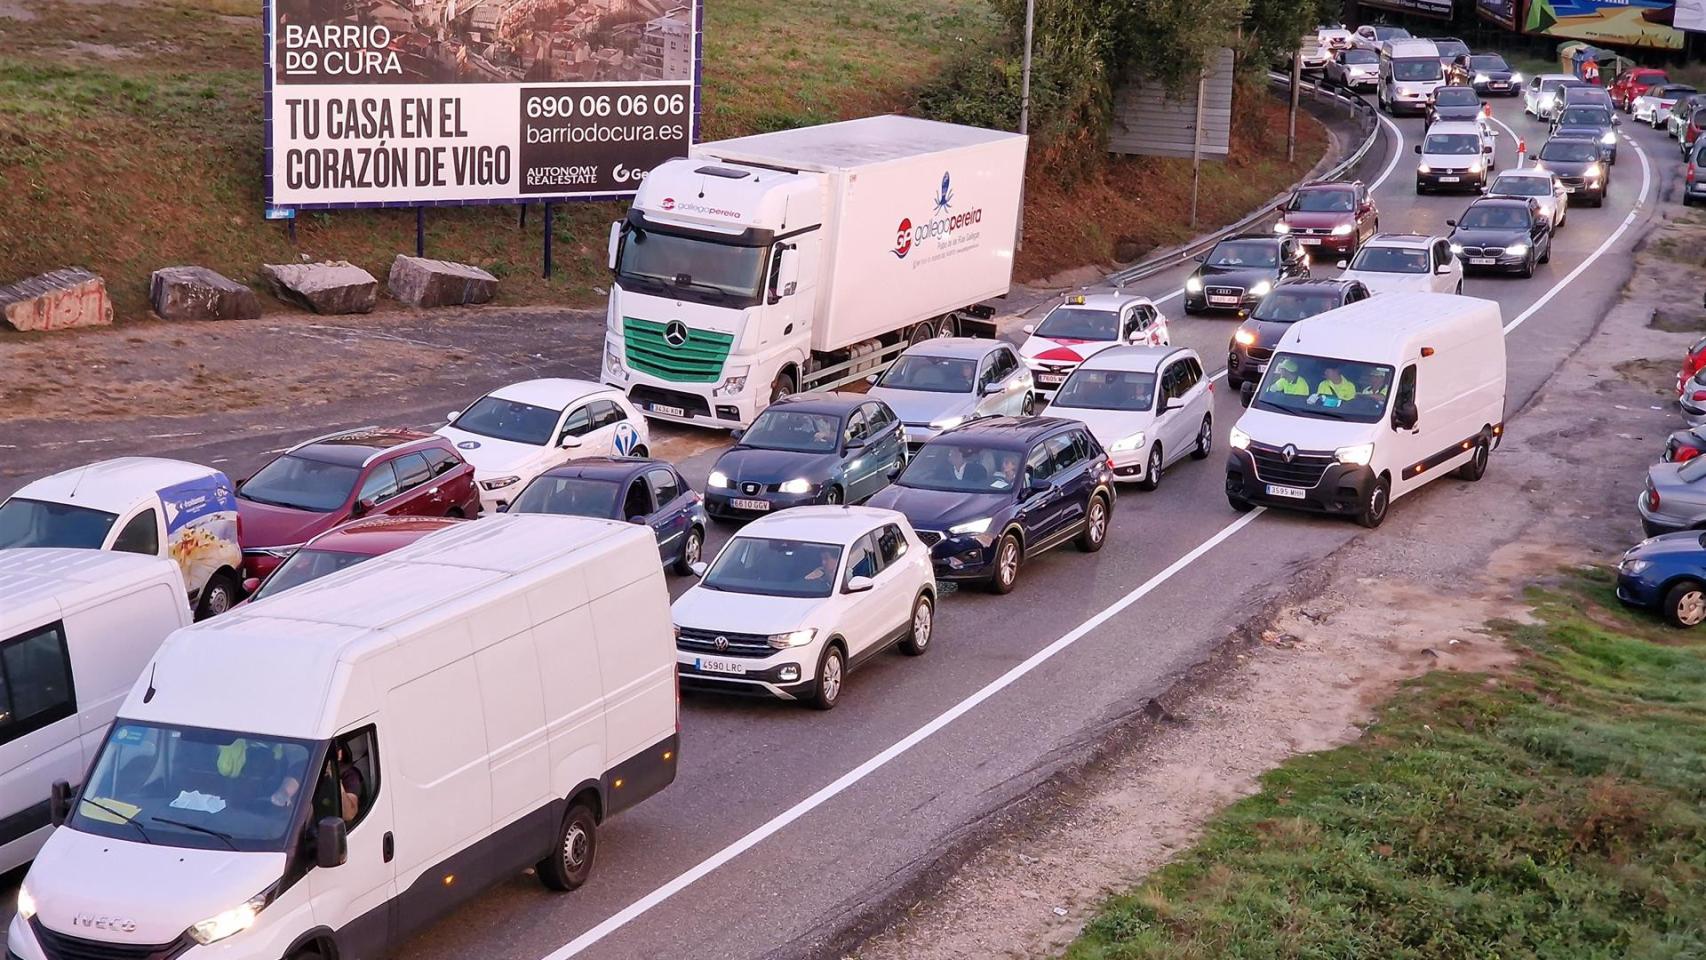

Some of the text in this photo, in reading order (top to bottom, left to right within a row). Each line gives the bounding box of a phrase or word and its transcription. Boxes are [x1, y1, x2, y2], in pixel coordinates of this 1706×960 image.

[286, 25, 391, 49] BARRIO
[286, 51, 403, 75] DO CURA
[527, 93, 684, 118] 690 06 06 06
[285, 97, 468, 140] TU CASA EN EL
[527, 122, 684, 143] barriodocura.es
[287, 140, 511, 190] CORAZÓN DE VIGO
[527, 165, 598, 177] AUTONOMY
[1271, 486, 1288, 495] 3595
[703, 660, 742, 673] 4590 LRC
[73, 912, 136, 932] IVECO
